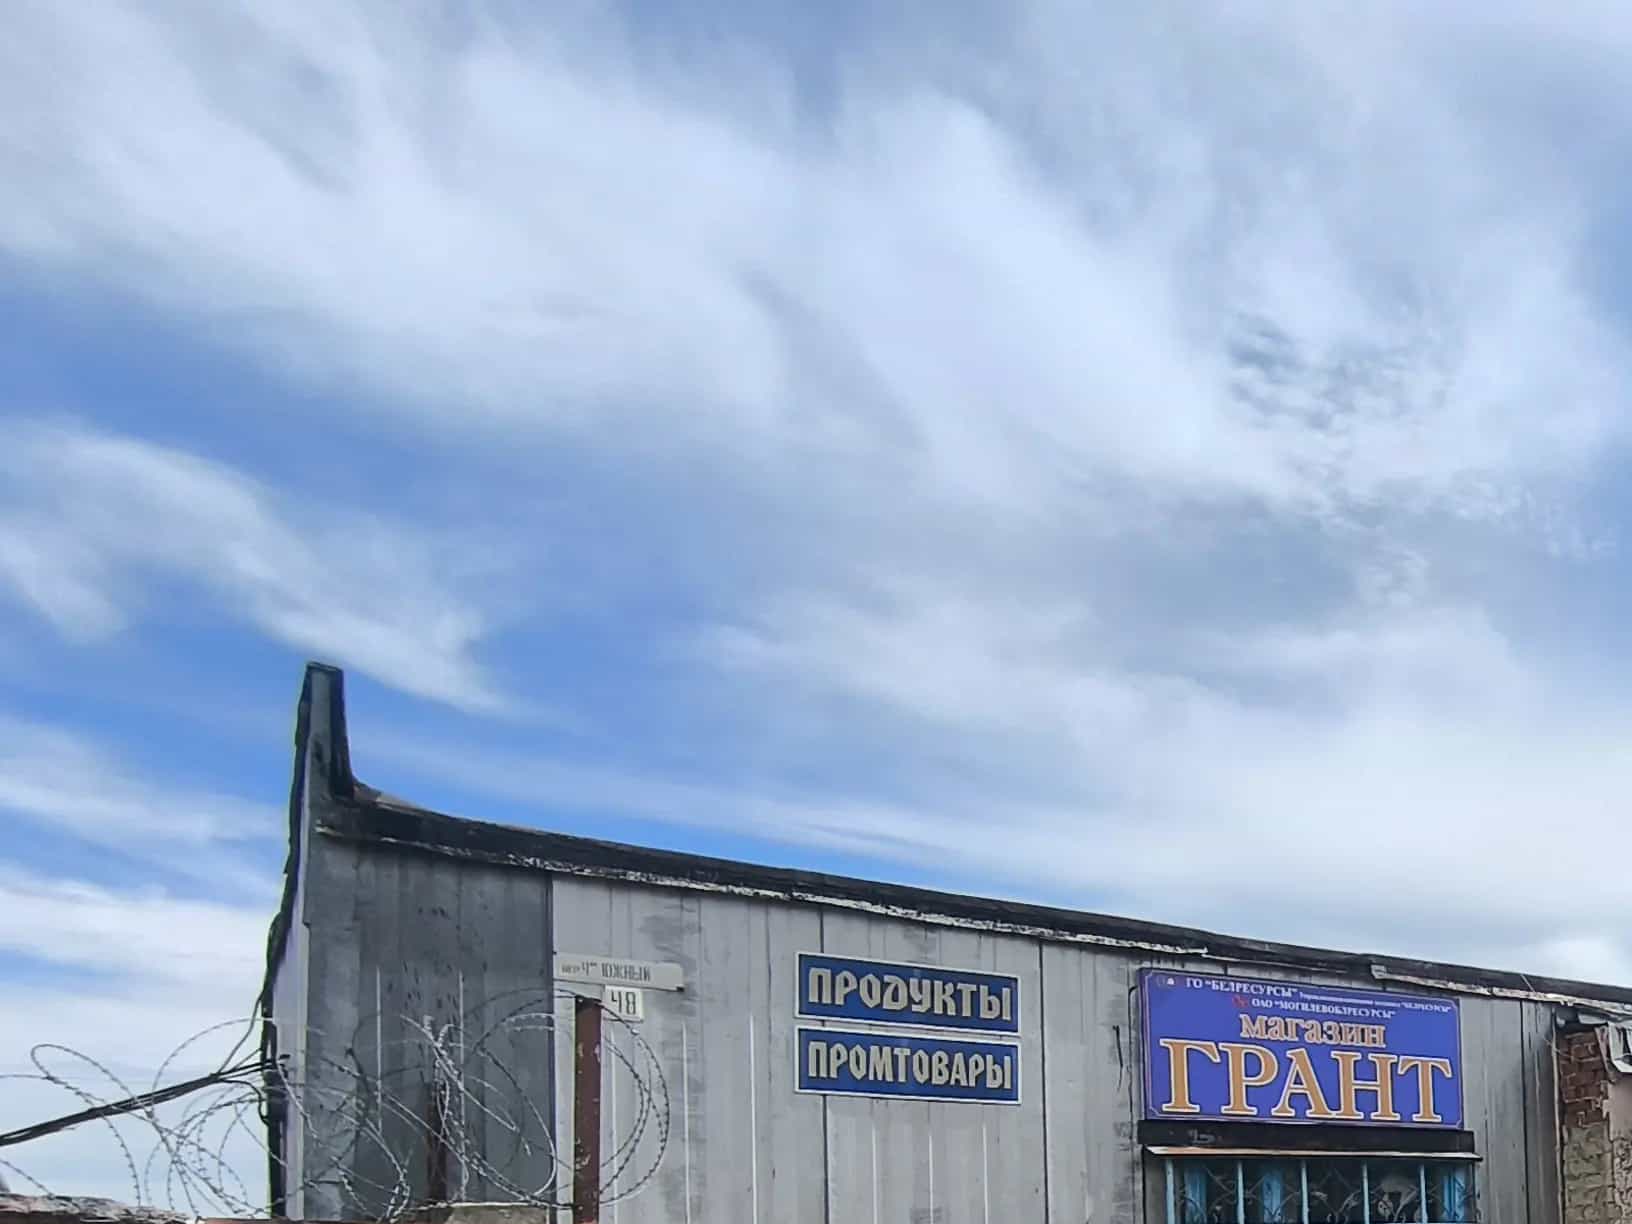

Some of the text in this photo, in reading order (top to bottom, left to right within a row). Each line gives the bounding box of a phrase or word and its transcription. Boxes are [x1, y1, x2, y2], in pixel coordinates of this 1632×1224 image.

[601, 963, 650, 981] ЮЖНЫЙ
[1186, 977, 1203, 989] ГО
[611, 991, 636, 1015] 48
[808, 967, 1012, 1021] ПРОДУКТЫ
[1239, 1013, 1386, 1048] магазин
[808, 1041, 1012, 1089] ПРОМТОВАРЫ
[1159, 1038, 1453, 1122] ГРАНТ
